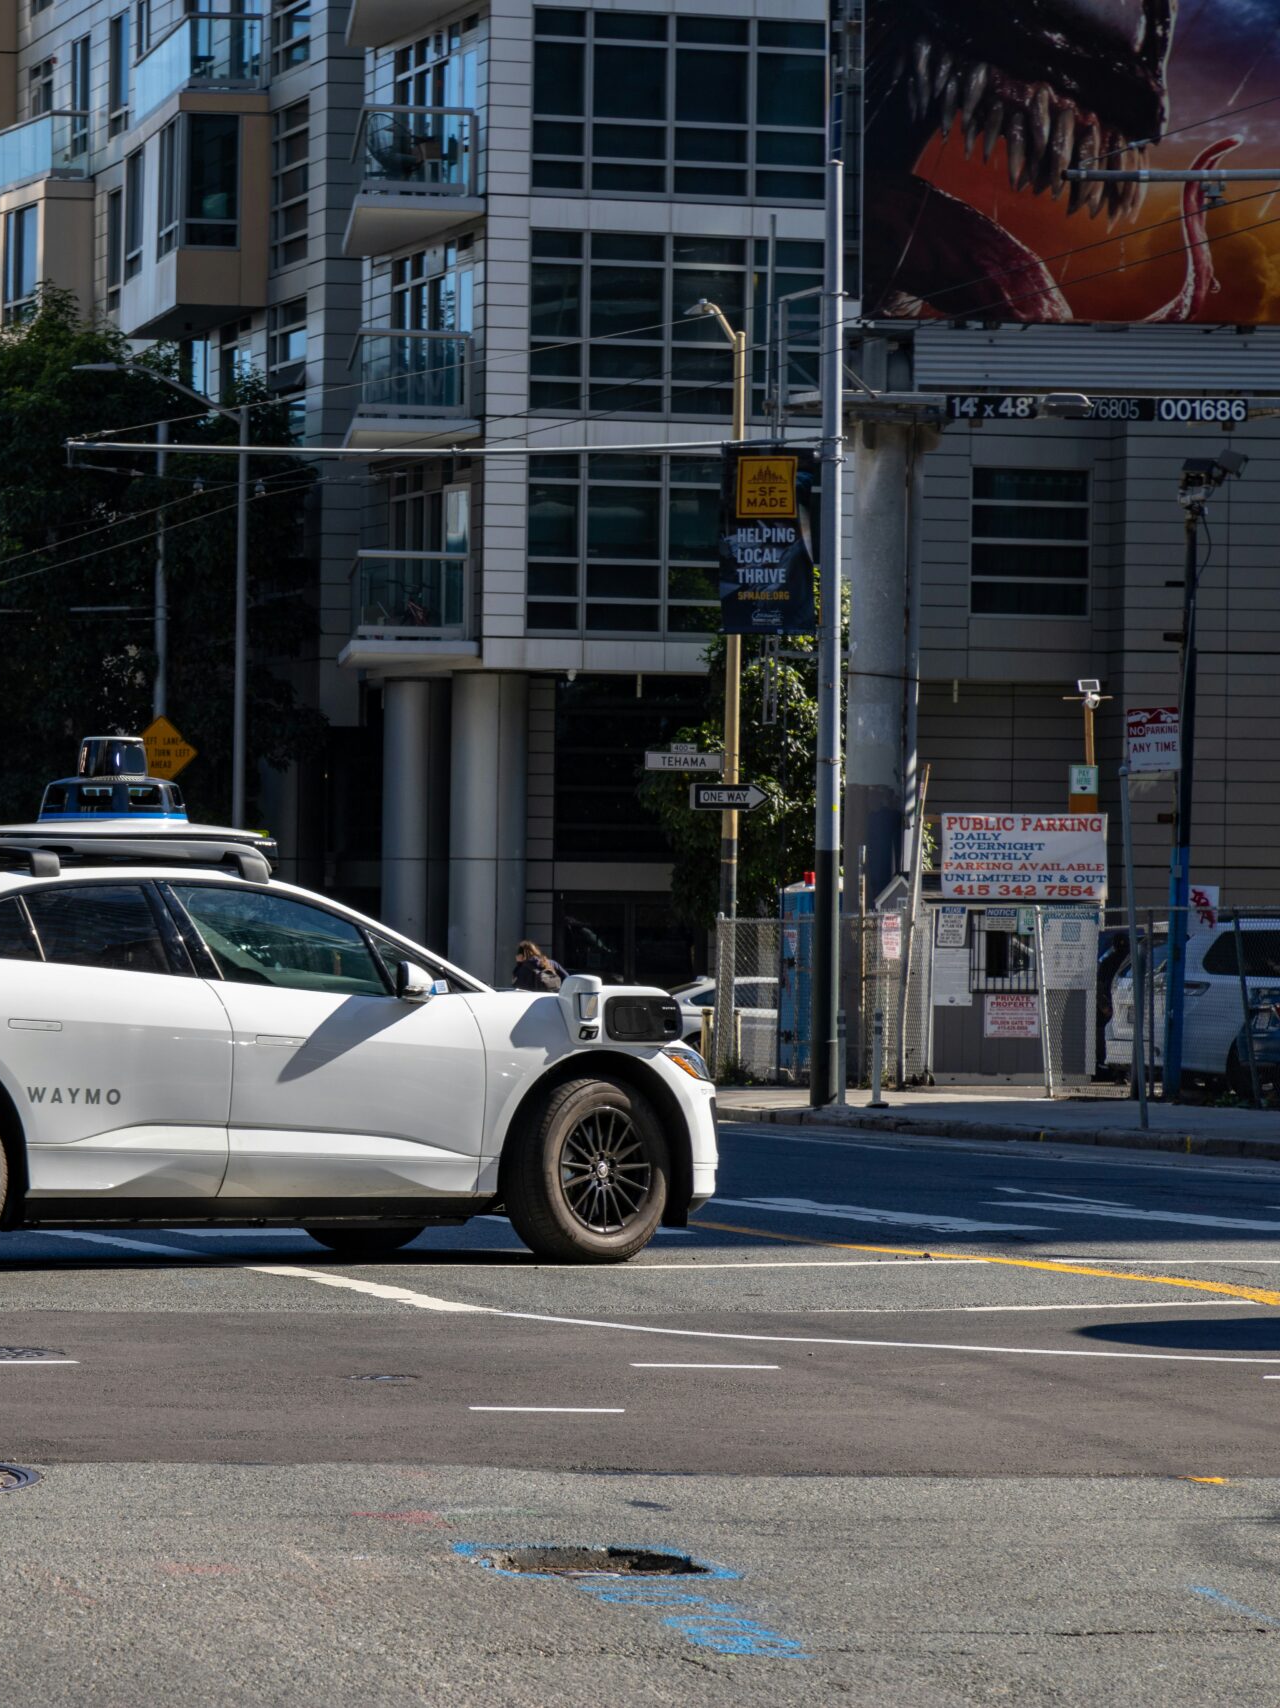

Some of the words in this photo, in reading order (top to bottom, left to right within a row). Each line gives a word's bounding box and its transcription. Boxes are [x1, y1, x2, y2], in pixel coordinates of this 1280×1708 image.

[952, 397, 979, 417] 14'
[983, 404, 995, 417] x
[998, 397, 1033, 417] 48'
[1160, 399, 1246, 421] 001686
[758, 486, 777, 496] SF
[746, 497, 788, 507] MADE
[736, 527, 795, 543] HELPING
[736, 548, 780, 564] LOCAL
[736, 568, 787, 584] THRIVE
[737, 591, 790, 600] SFMADE.ORG
[1129, 726, 1145, 736] NO
[1145, 725, 1178, 735] PARKING
[1132, 742, 1151, 753] ANY
[661, 756, 707, 767] TEHAMA
[702, 791, 724, 801] ONE
[727, 791, 749, 802] WAY
[946, 816, 1015, 832] PUBLIC
[1021, 817, 1102, 832] PARKING
[943, 862, 1013, 871] PARKING
[1018, 863, 1105, 871] AVAILABLE
[944, 873, 1032, 883] UNLIMITED
[1037, 874, 1053, 883] IN
[1059, 875, 1068, 883] &
[1073, 875, 1107, 883] OUT
[953, 884, 990, 896] 415
[998, 884, 1037, 896] 342
[1044, 885, 1095, 896] 7554
[988, 908, 1016, 916] NOTICE
[26, 1086, 122, 1106] WAYMO
